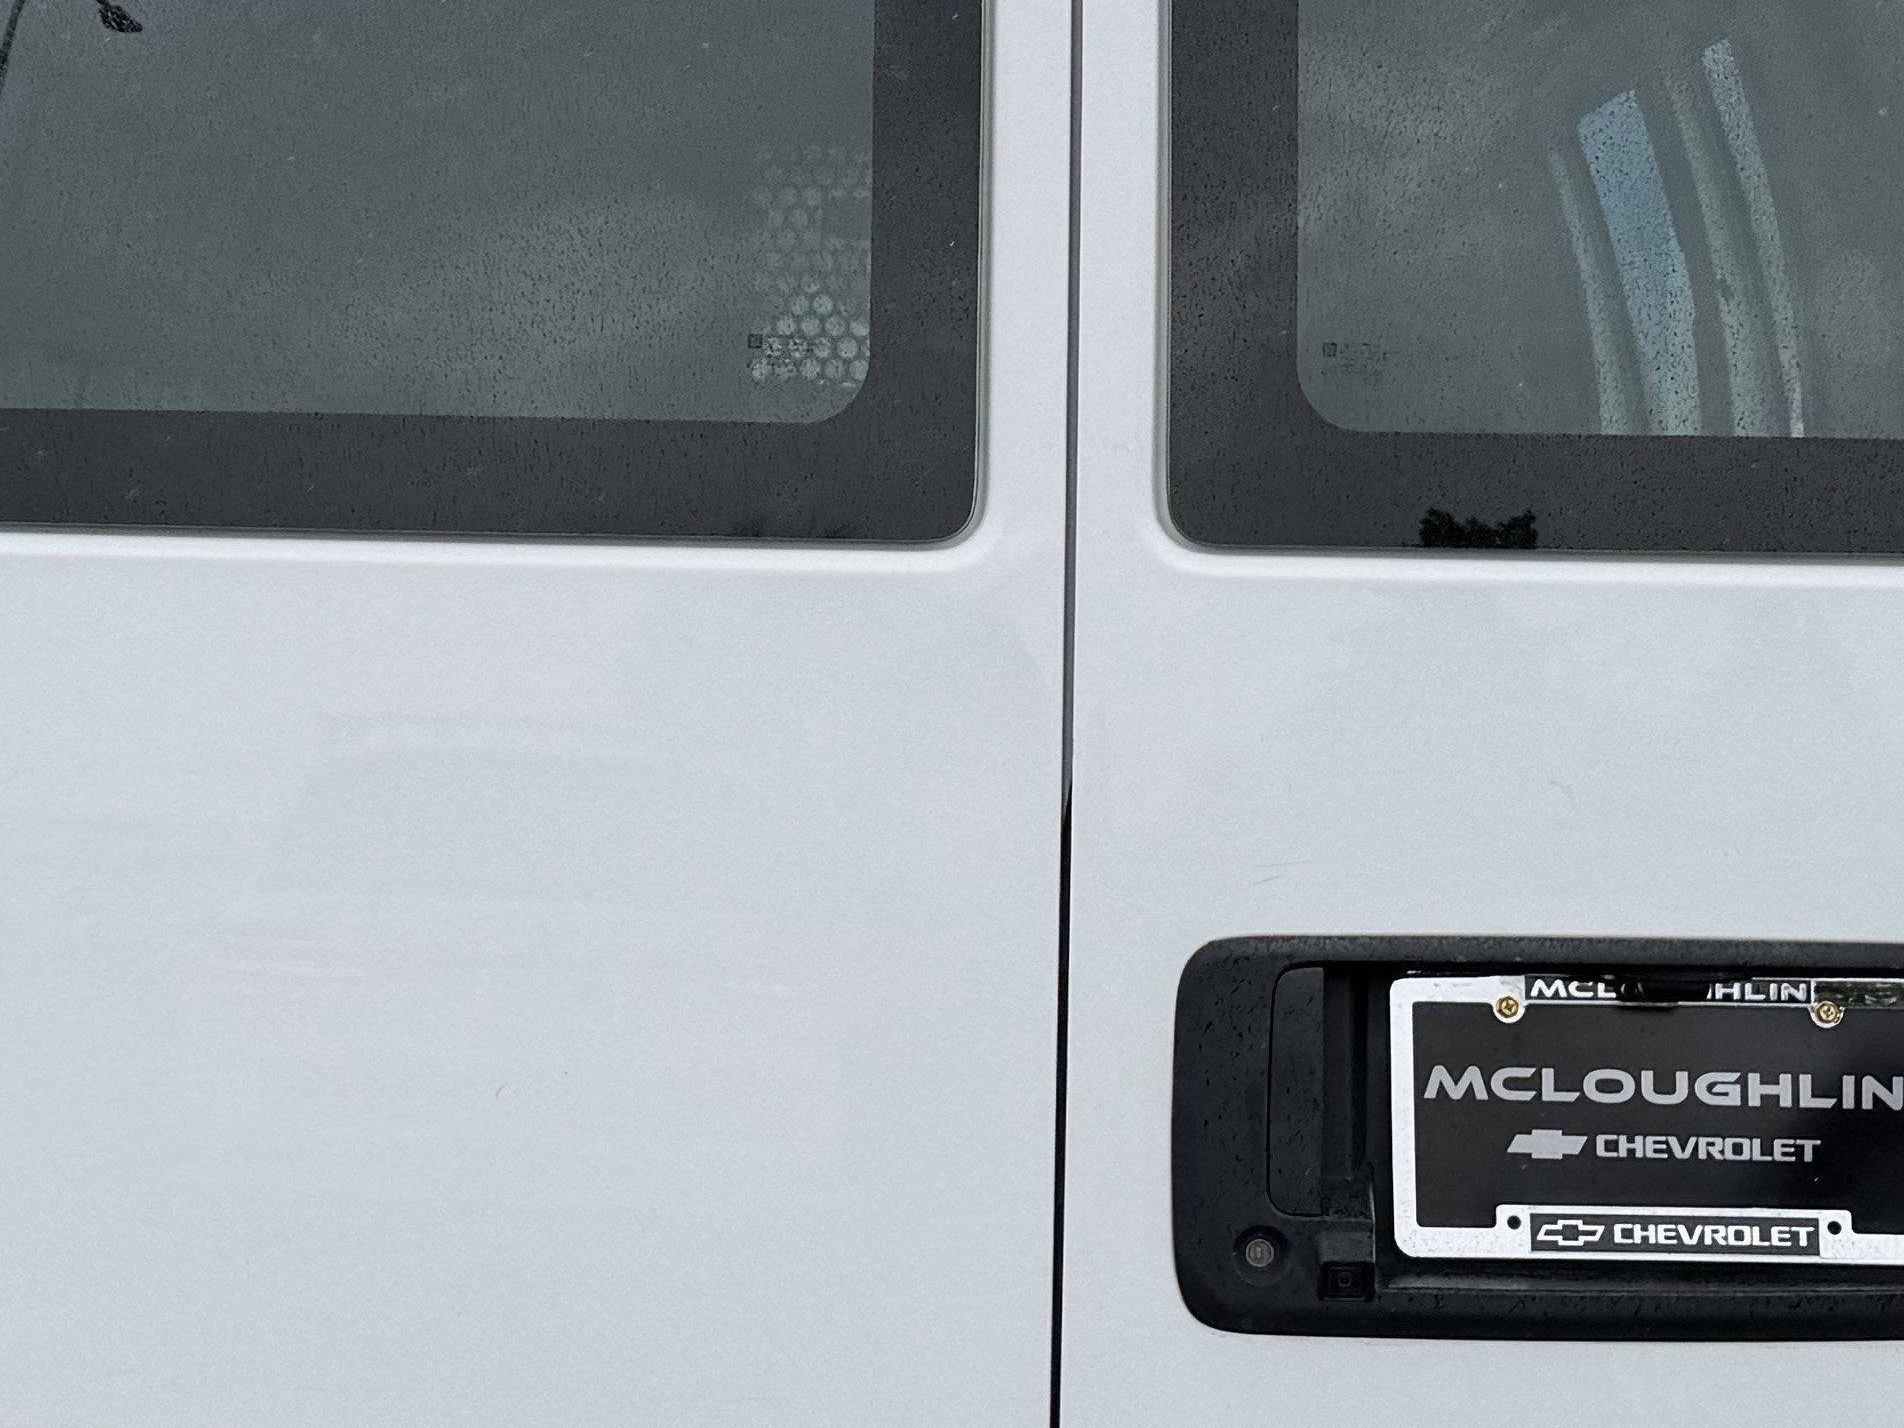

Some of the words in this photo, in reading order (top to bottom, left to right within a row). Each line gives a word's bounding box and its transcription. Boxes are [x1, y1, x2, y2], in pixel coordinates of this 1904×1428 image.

[1530, 977, 1807, 1001] MCLHLIN
[1424, 1065, 1904, 1111] MCLOUGHLIN
[1596, 1134, 1821, 1162] CHEVROLET
[1613, 1223, 1814, 1248] CHEVROLET
